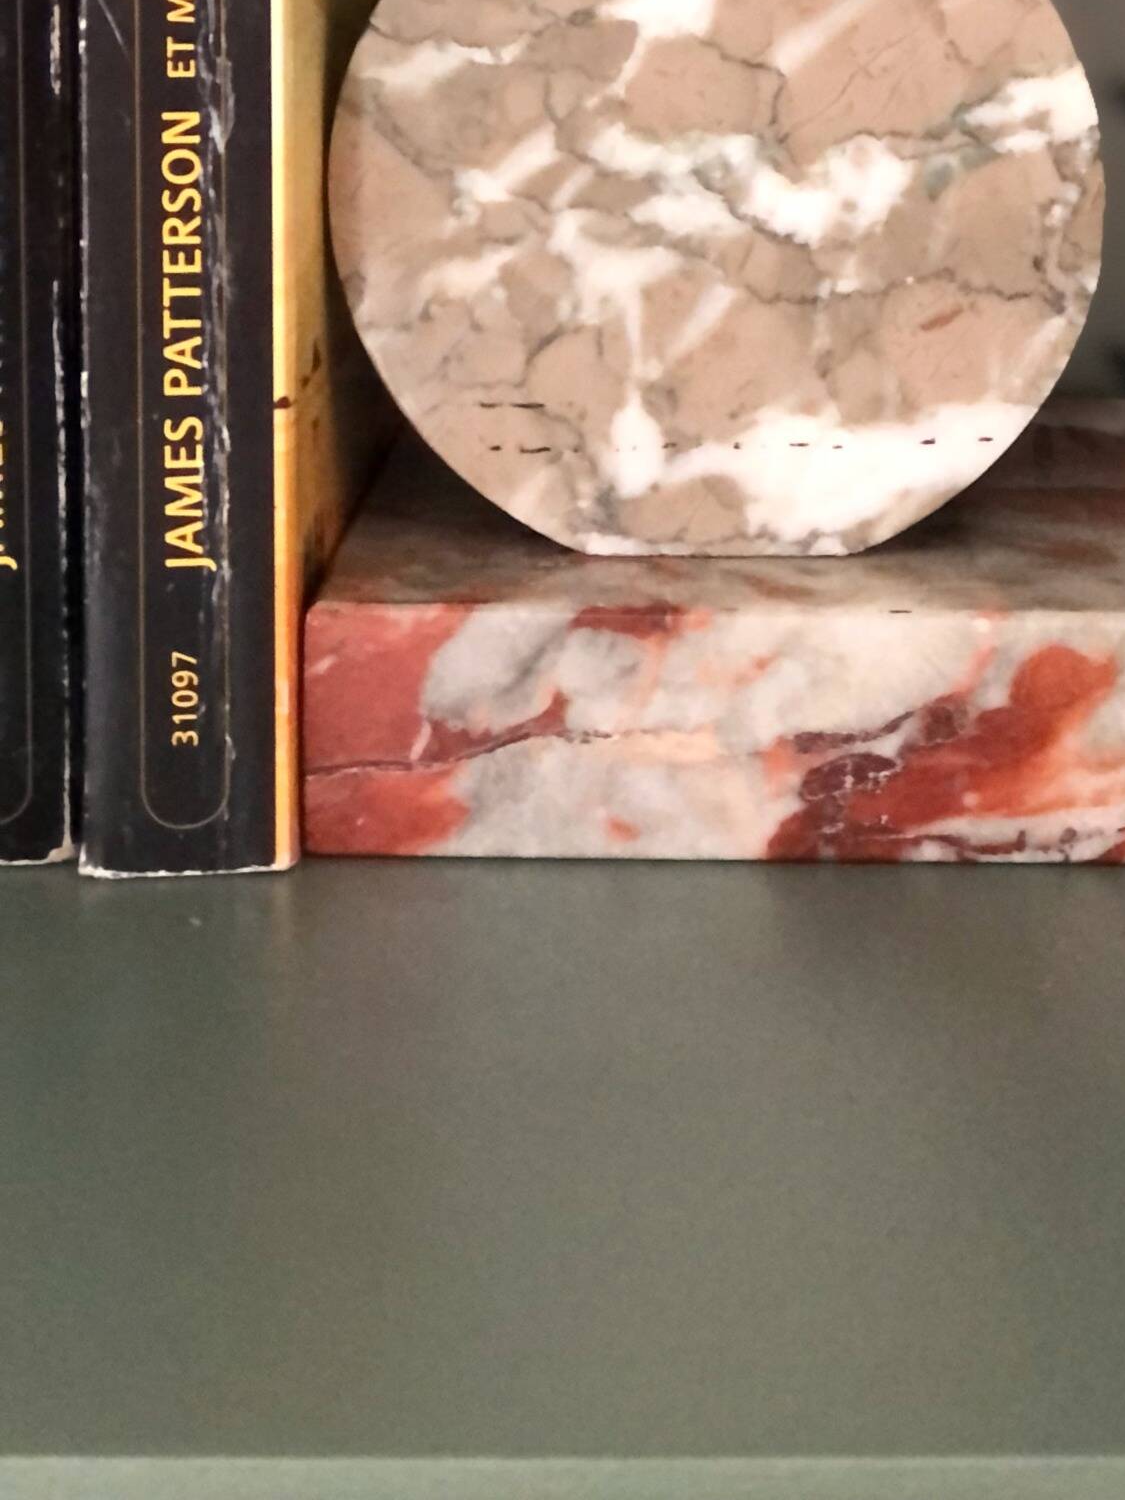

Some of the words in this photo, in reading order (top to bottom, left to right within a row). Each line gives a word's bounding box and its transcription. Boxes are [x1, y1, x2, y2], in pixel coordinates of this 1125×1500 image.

[166, 36, 196, 79] ET
[161, 110, 203, 399] PATTERSON
[164, 416, 217, 571] JAMES
[171, 650, 200, 749] 31097
